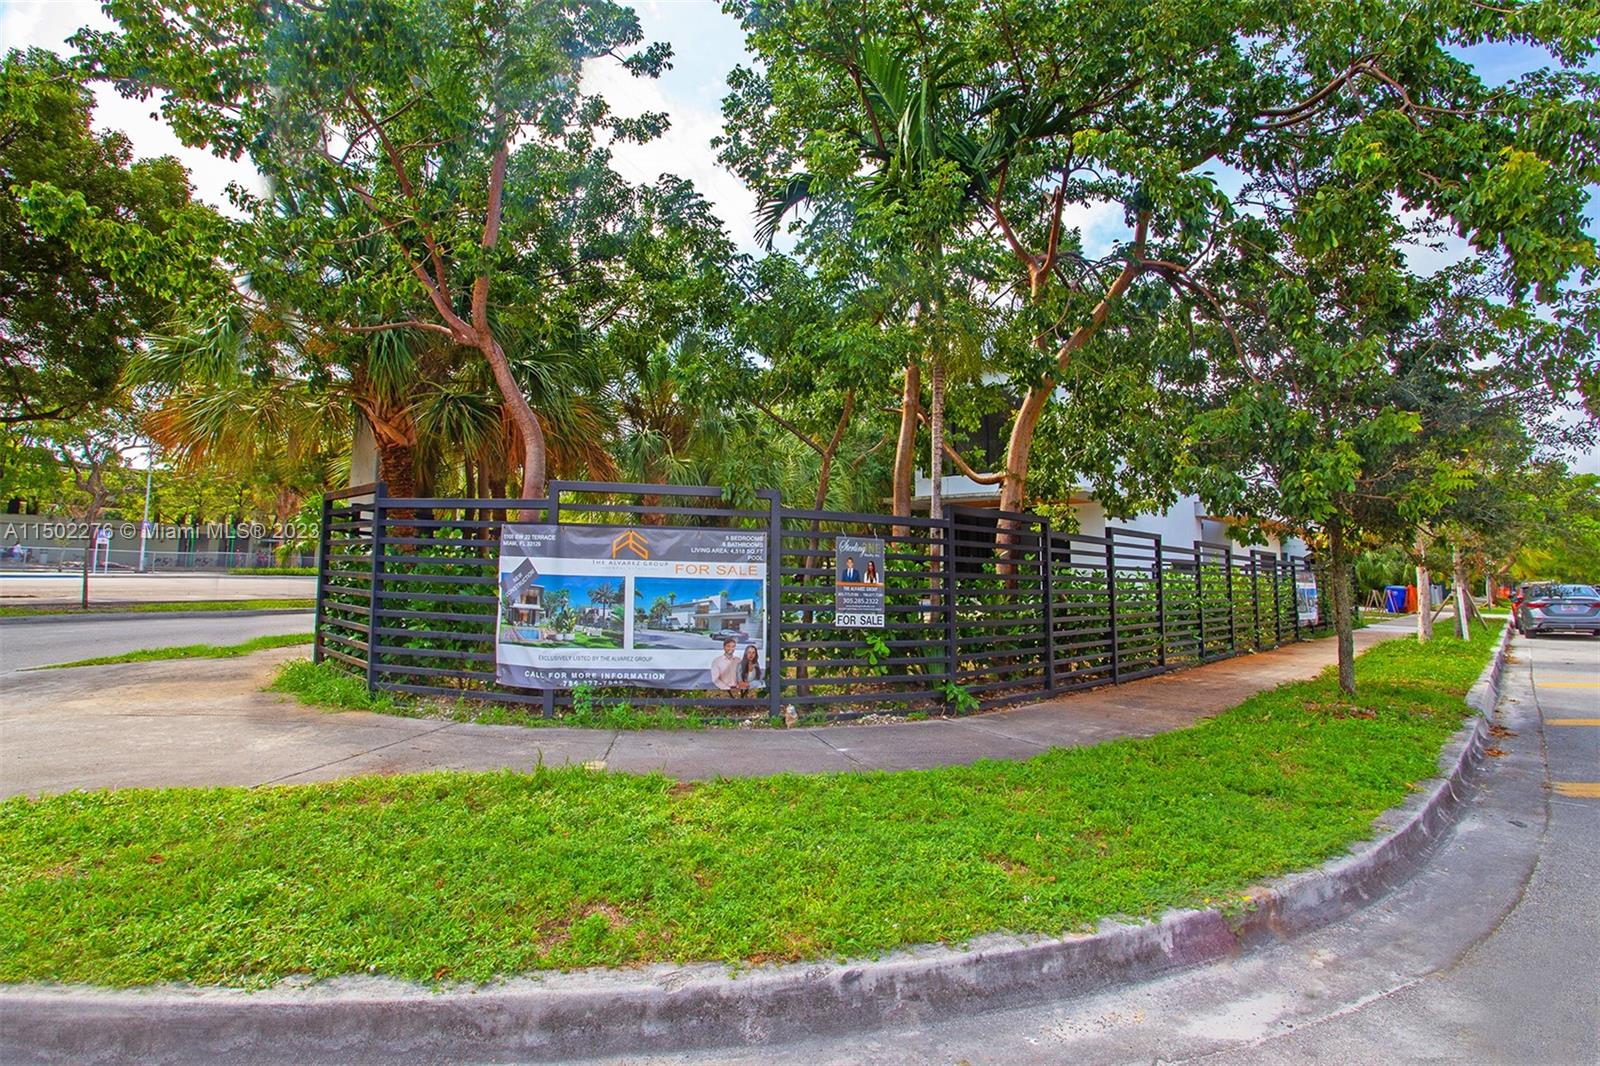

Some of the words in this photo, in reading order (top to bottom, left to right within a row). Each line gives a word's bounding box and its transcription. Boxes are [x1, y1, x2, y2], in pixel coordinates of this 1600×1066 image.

[675, 564, 710, 575] FOR
[716, 564, 758, 576] SALE
[837, 615, 857, 625] FOR
[860, 615, 883, 626] SALE
[524, 670, 545, 678] CALL
